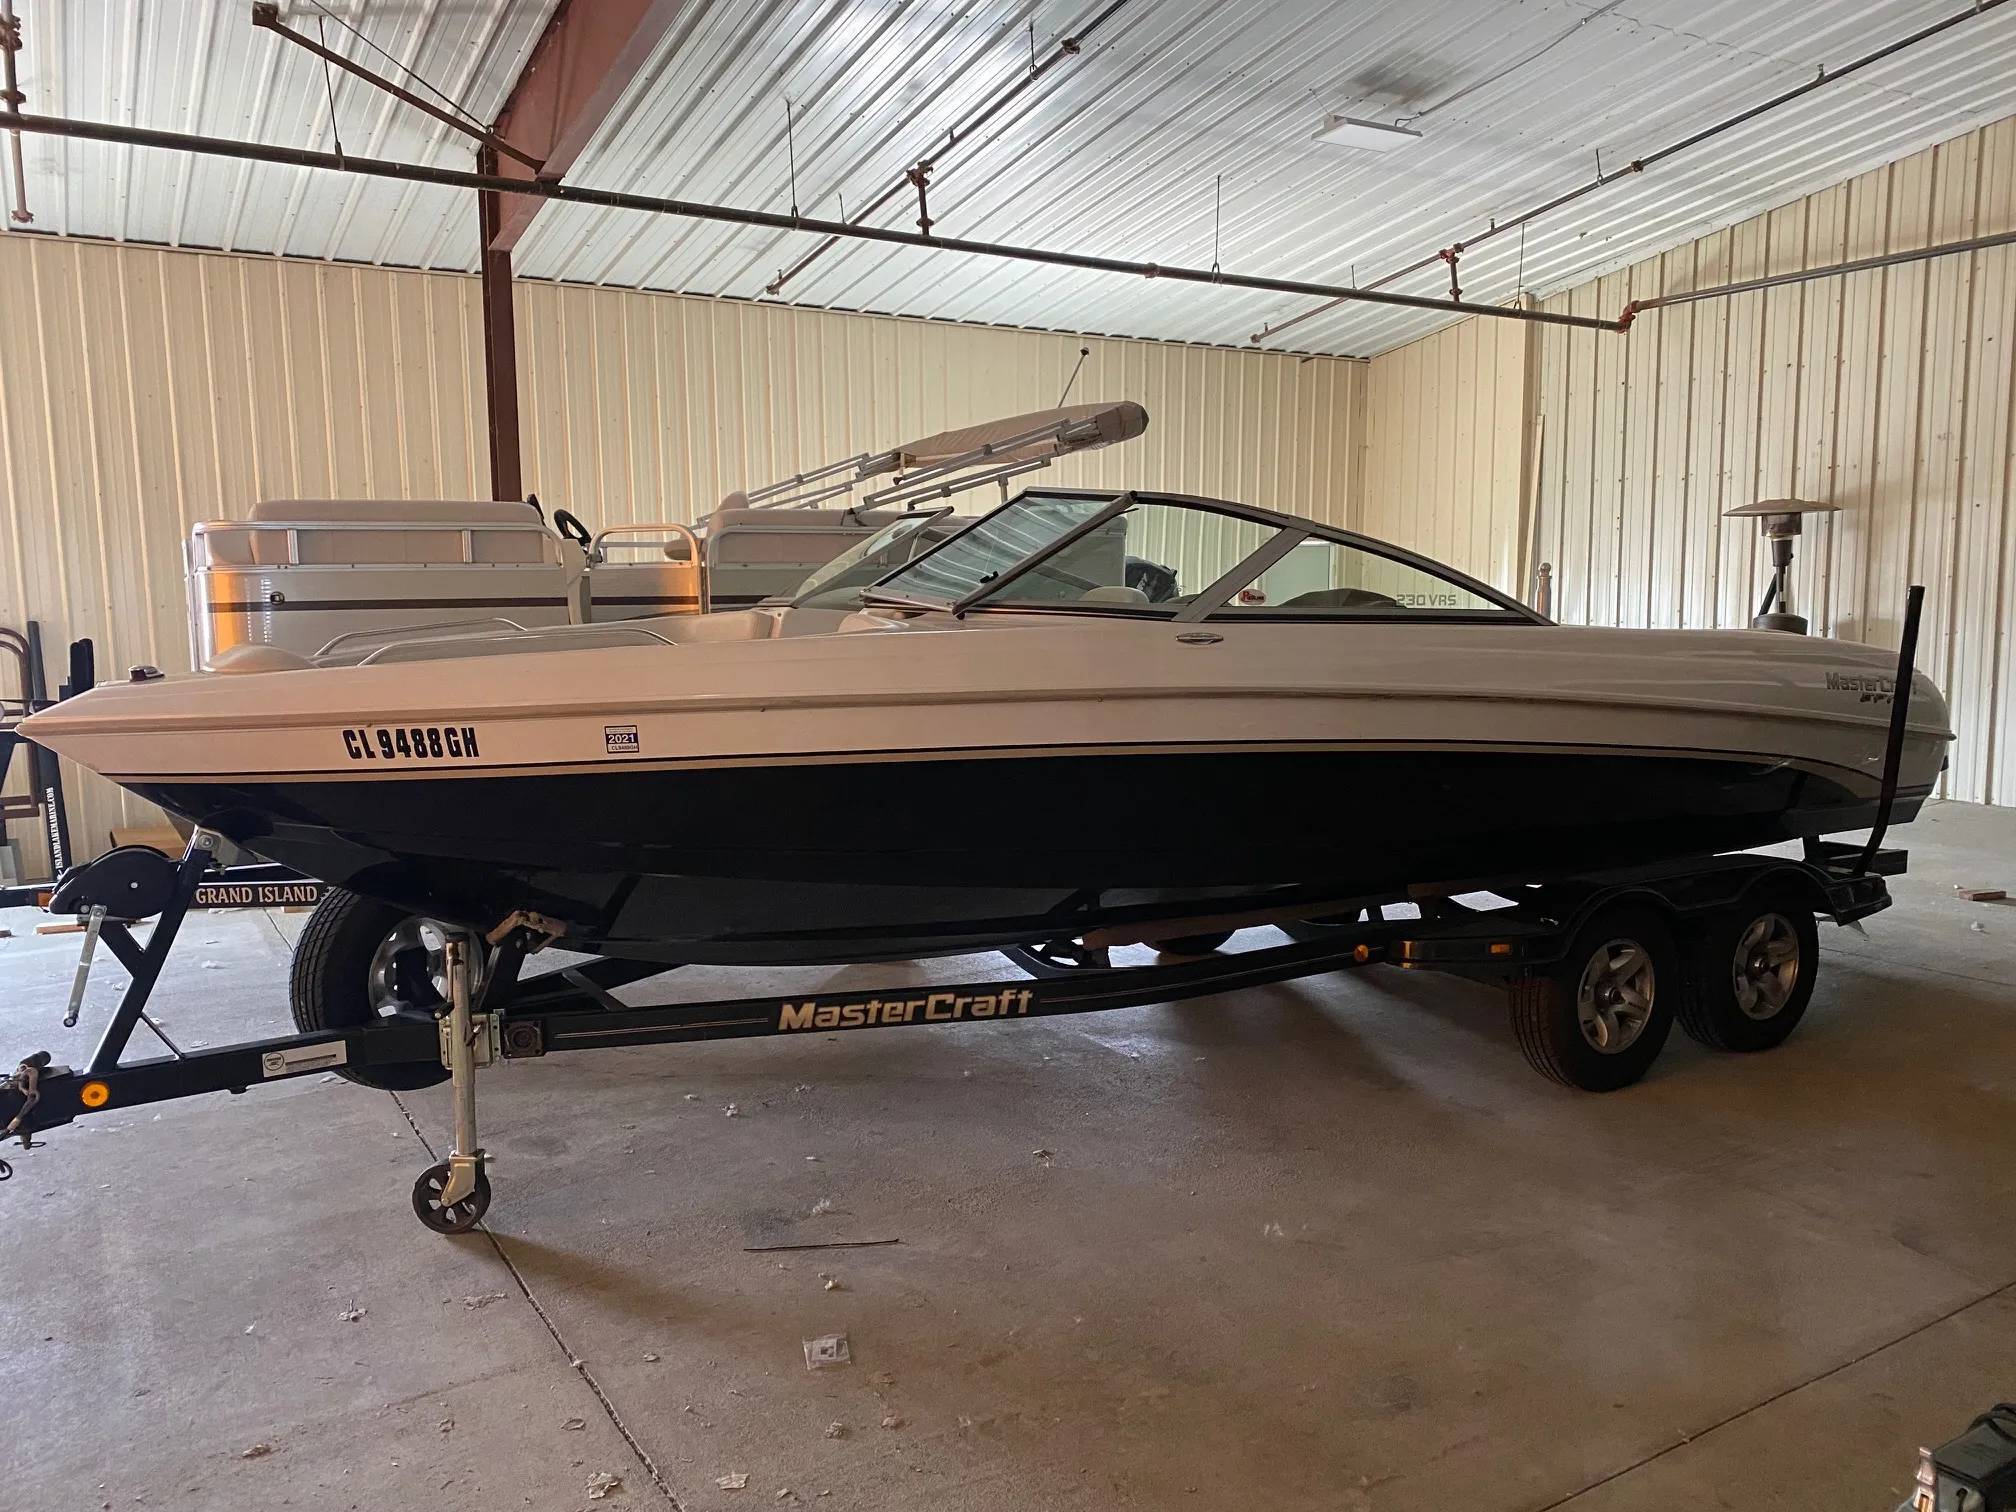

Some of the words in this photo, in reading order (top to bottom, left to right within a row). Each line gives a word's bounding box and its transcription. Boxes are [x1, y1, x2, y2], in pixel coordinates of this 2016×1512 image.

[1396, 593, 1425, 606] 230
[1428, 594, 1457, 606] VRS
[608, 734, 635, 744] 2021
[195, 887, 253, 904] GRAND
[258, 885, 318, 903] ISLAND
[777, 988, 1033, 1031] MasterCraft
